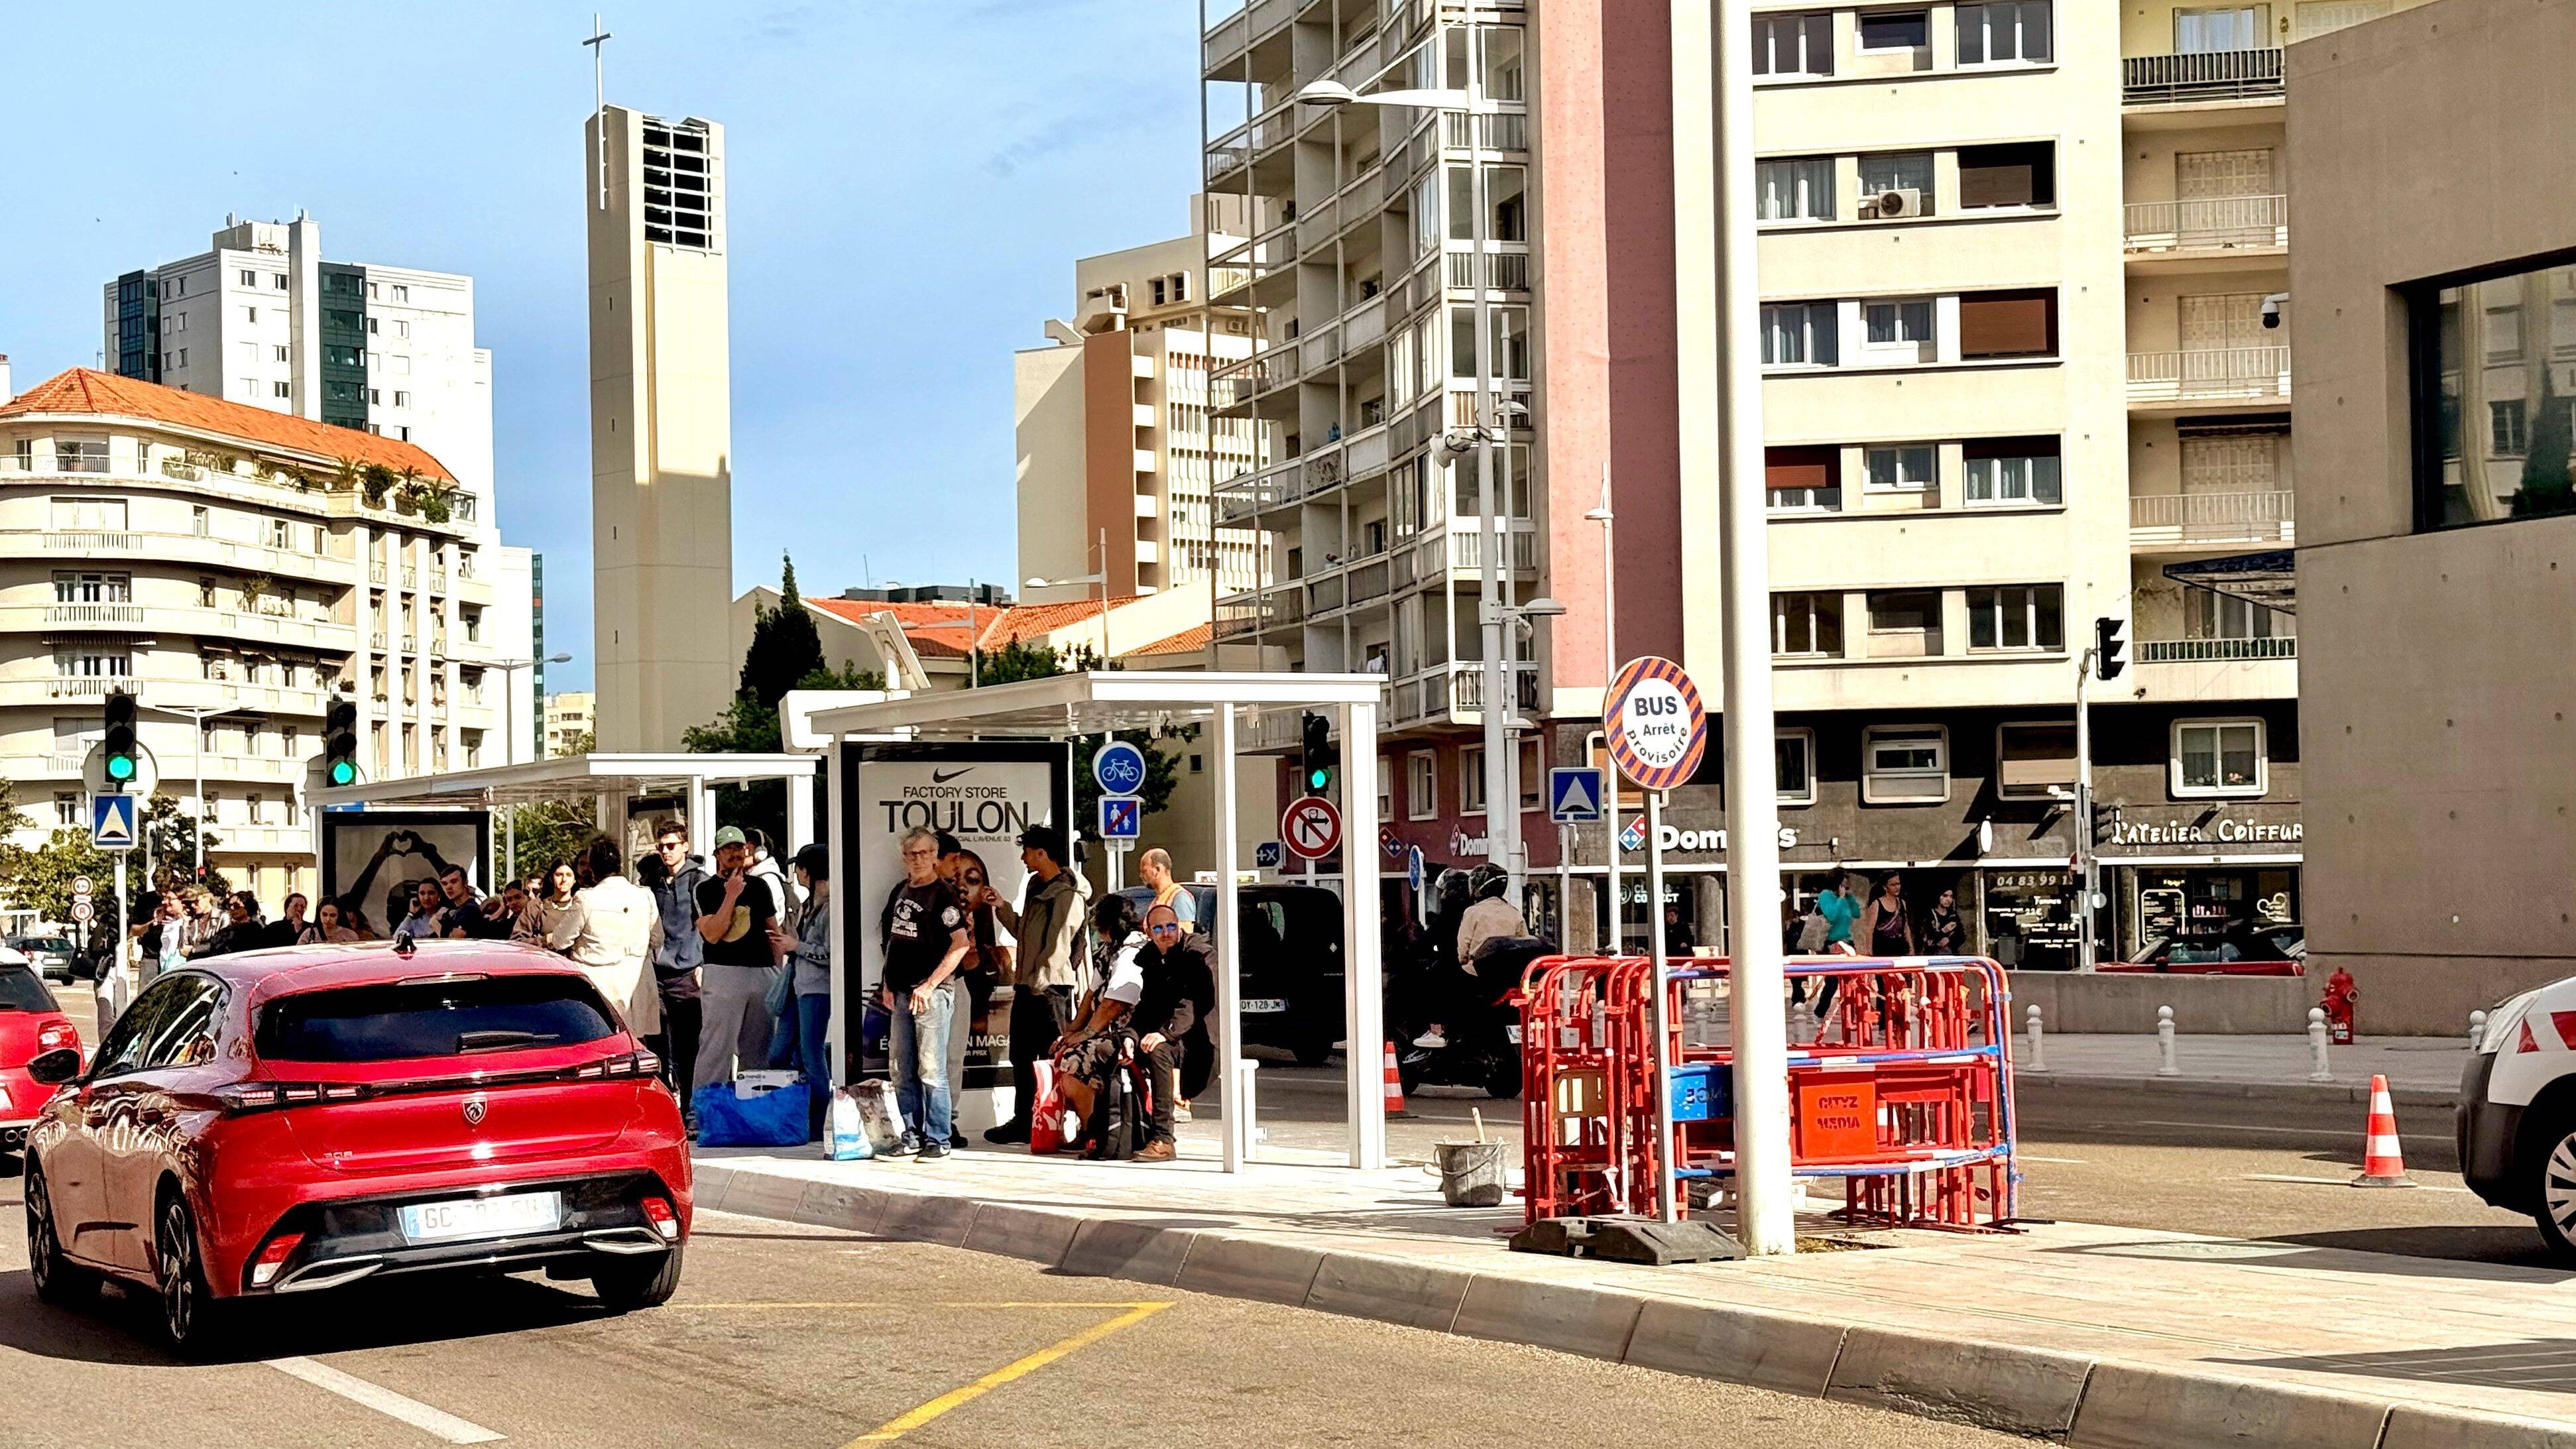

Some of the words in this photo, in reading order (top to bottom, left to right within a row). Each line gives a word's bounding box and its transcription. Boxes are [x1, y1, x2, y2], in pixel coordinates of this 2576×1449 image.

[1634, 695, 1678, 717] BUS
[1643, 723, 1676, 736] Arrêt
[1626, 726, 1688, 764] provisoire
[904, 786, 962, 799] FACTORY
[965, 786, 1008, 799] STORE
[879, 800, 1029, 833] TOULON
[1659, 821, 1797, 850] Dom's
[1997, 876, 2013, 887] 04
[2018, 876, 2035, 887] 83
[2039, 875, 2056, 886] 99
[1818, 1096, 1859, 1109] CITYZ
[1817, 1116, 1860, 1130] MEDIA
